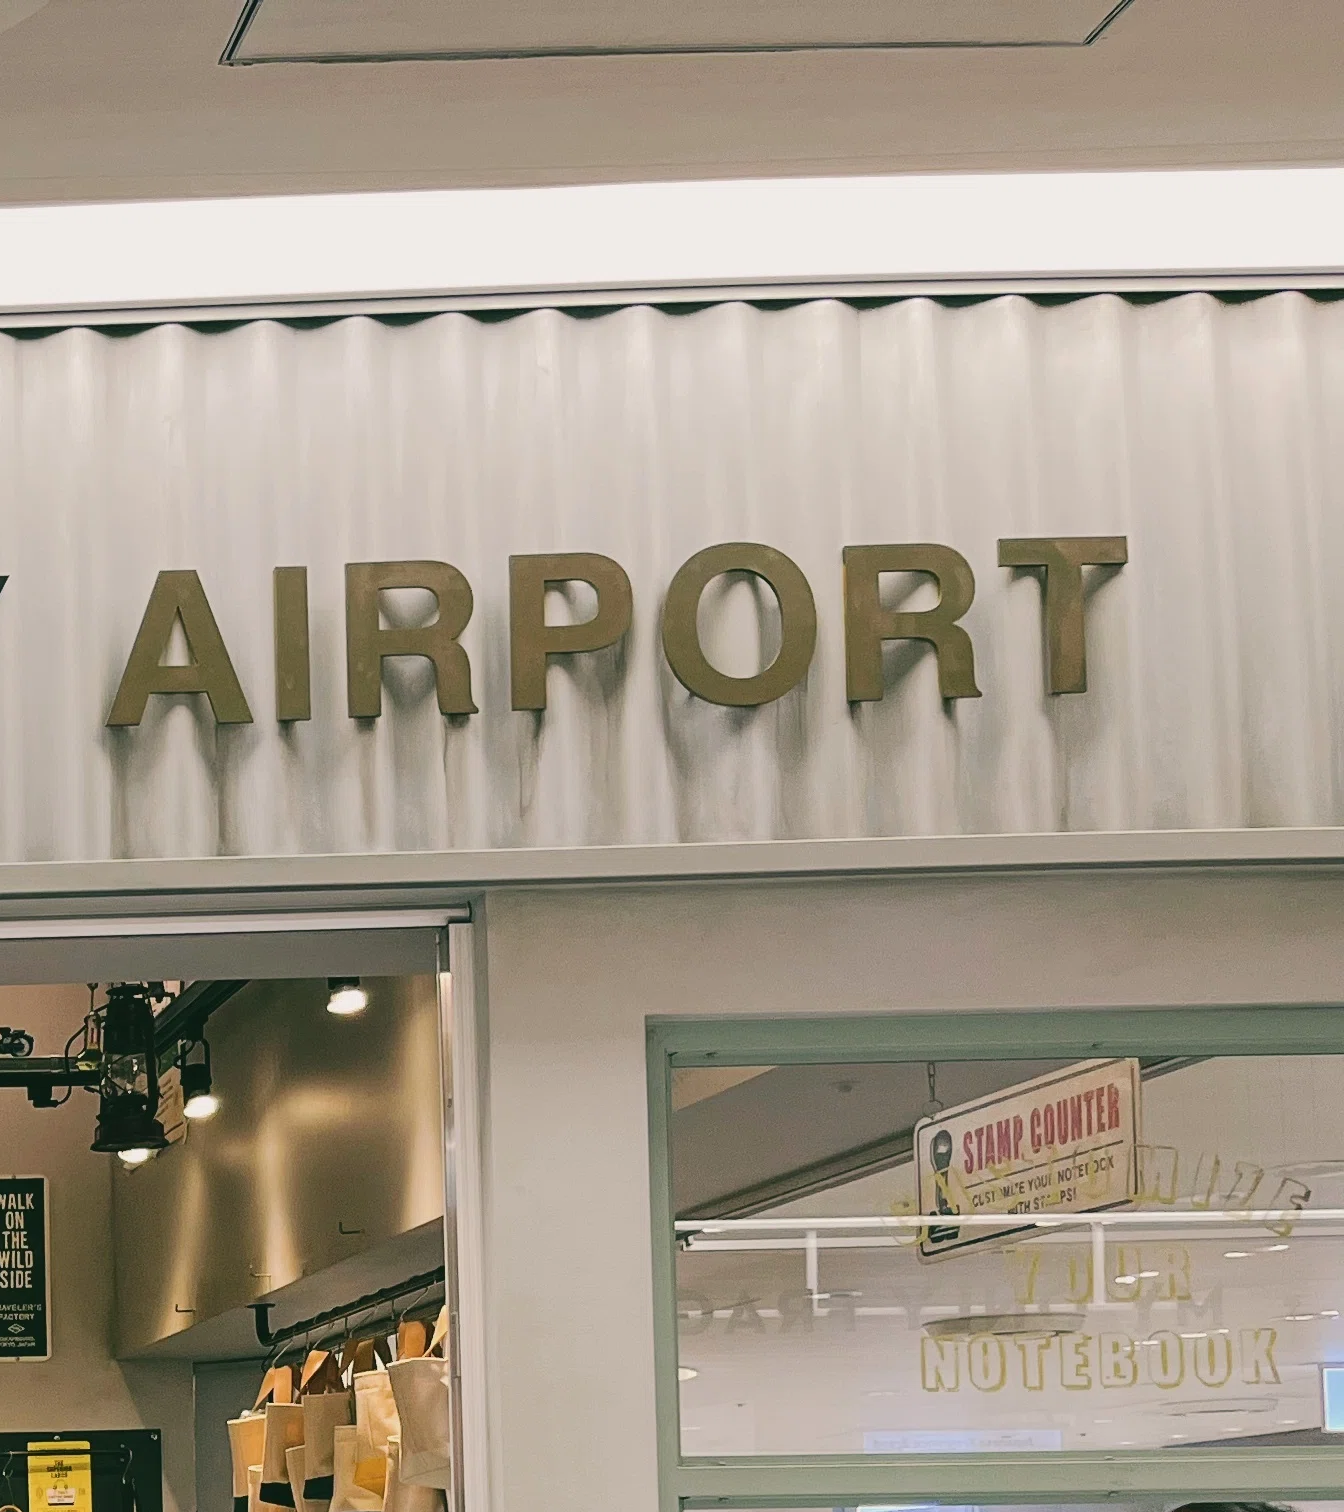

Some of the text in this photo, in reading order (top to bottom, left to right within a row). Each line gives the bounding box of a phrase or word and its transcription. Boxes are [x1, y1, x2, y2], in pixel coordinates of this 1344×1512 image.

[106, 536, 1130, 728] AIRPORT
[963, 1083, 1120, 1174] STAMP COUNTER
[2, 1231, 28, 1249] THE
[5, 1211, 24, 1229] ON
[0, 1270, 33, 1289] SIDE
[920, 1328, 1281, 1393] NOTEBOOK
